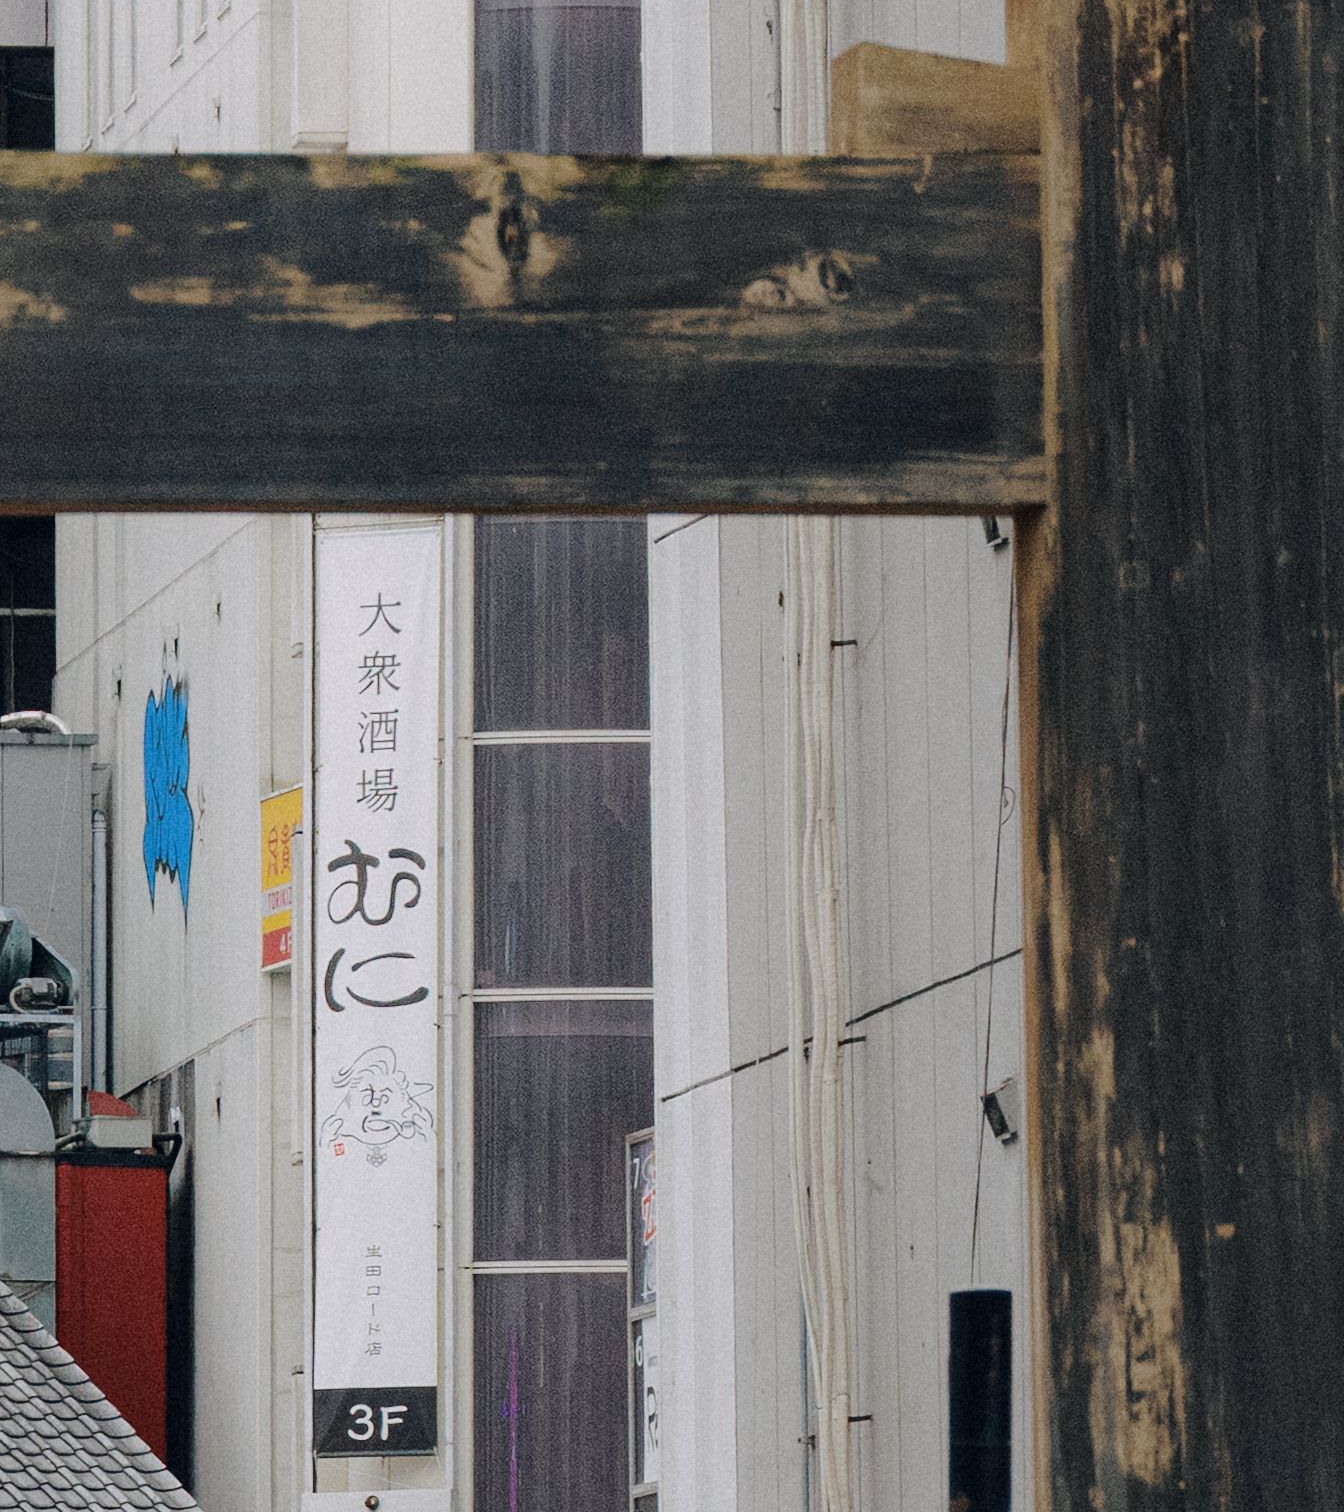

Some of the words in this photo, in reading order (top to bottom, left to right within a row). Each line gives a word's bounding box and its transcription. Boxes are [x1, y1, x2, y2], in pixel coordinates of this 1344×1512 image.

[355, 591, 403, 813] 大衆酒場
[324, 838, 431, 1012] むに
[365, 1245, 383, 1357] 生田ロード店
[347, 1403, 409, 1441] 3F
